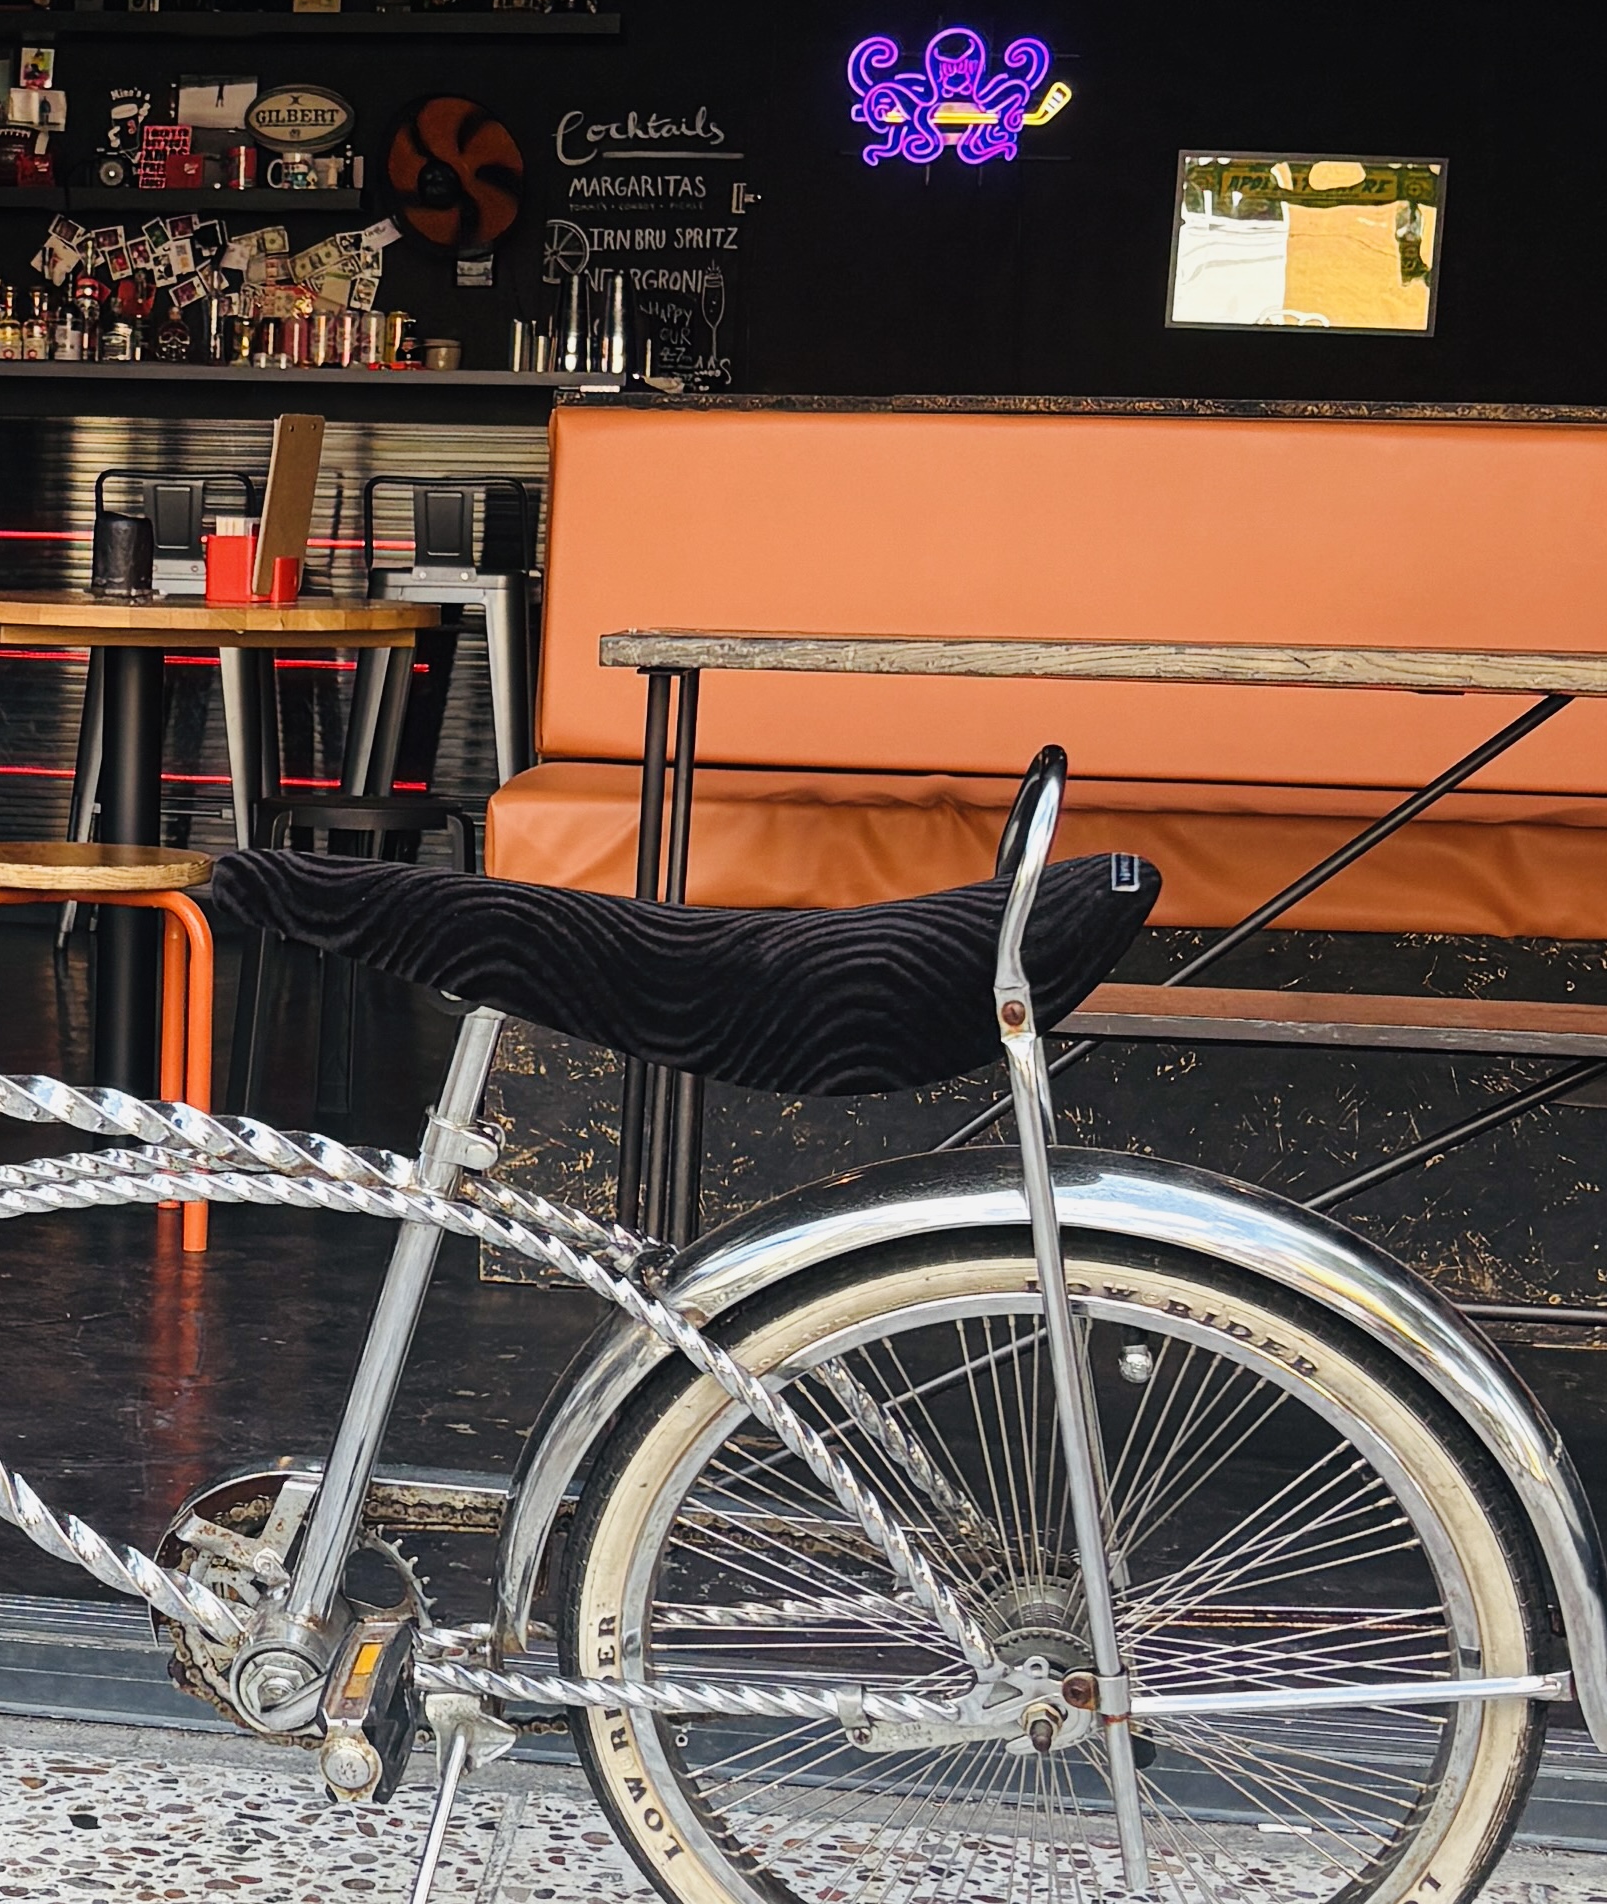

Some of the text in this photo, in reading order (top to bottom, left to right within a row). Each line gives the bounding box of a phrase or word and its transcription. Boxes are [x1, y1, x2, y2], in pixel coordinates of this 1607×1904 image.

[255, 108, 340, 125] GILBERT
[551, 105, 726, 167] Cocktails
[568, 174, 708, 199] MARGARITAS
[589, 227, 739, 252] IRN BRU SPRITZ
[1161, 1298, 1319, 1378] RIDER
[598, 1614, 685, 1862] LOW RIER
